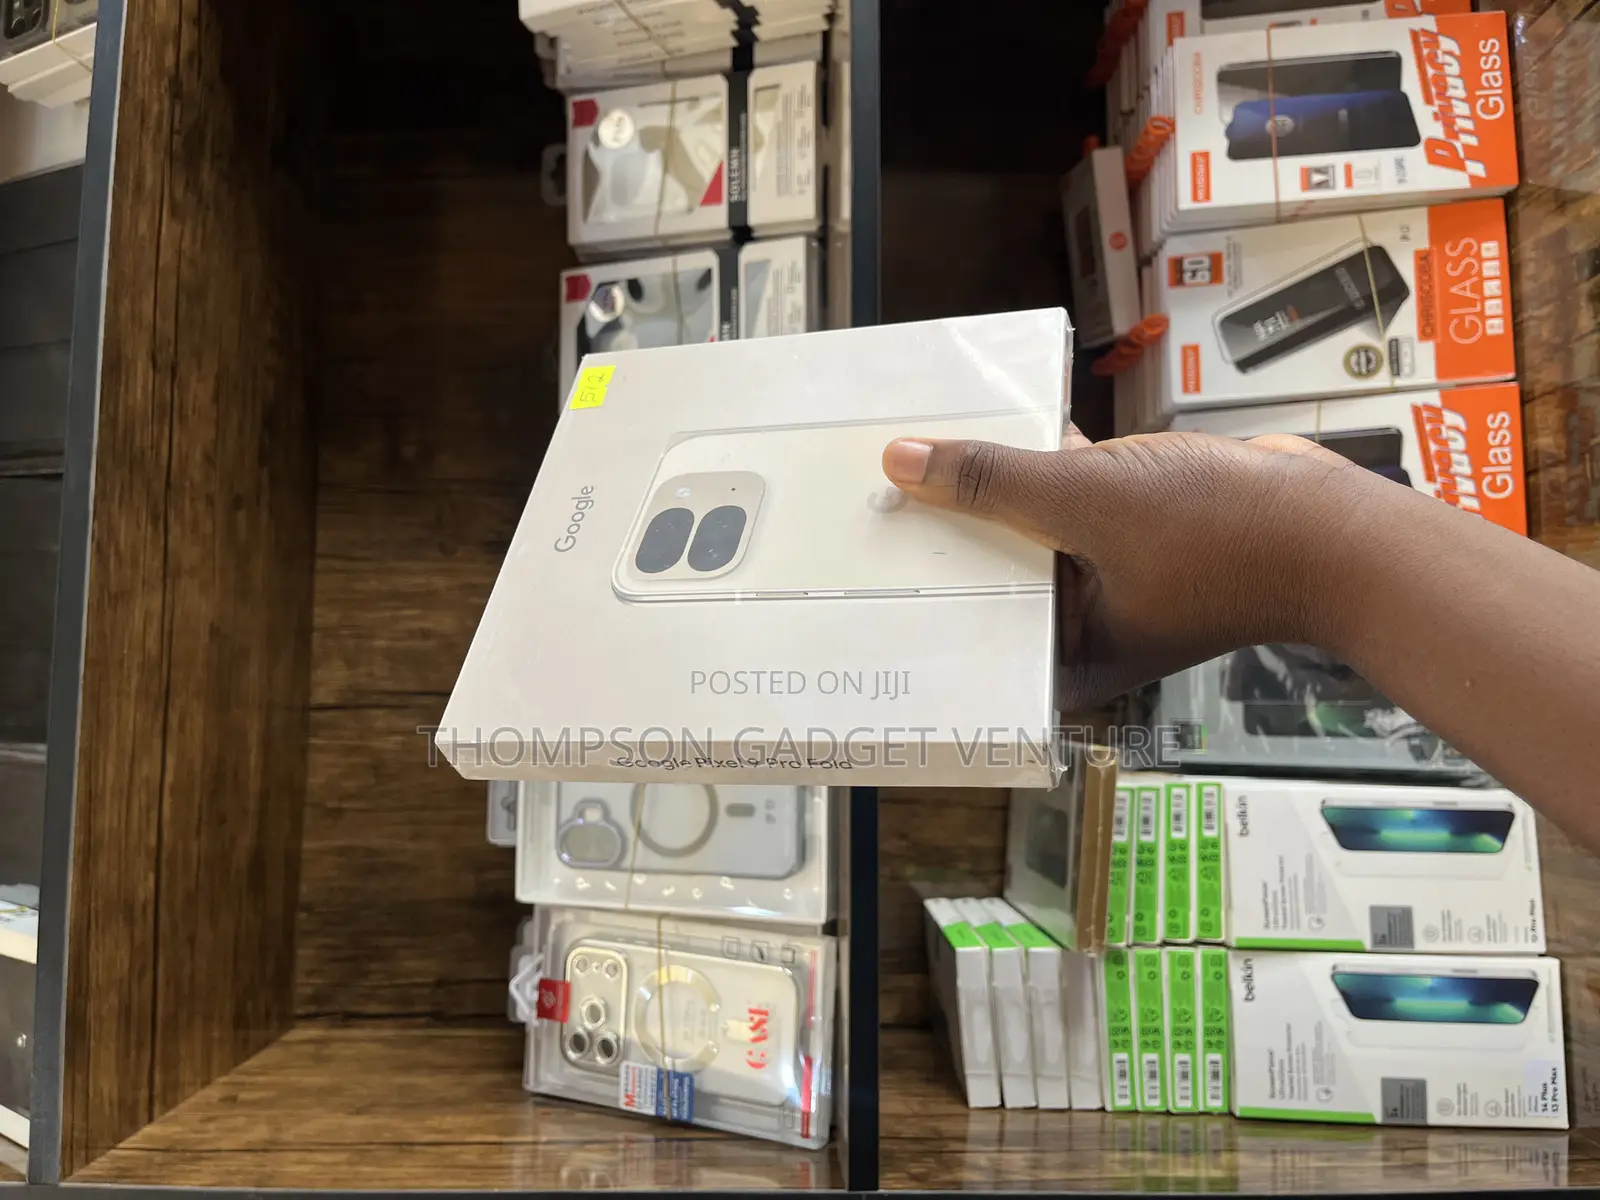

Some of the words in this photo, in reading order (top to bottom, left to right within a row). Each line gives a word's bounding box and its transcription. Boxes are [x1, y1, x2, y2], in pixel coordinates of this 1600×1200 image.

[1417, 28, 1487, 178] Privacy
[1475, 38, 1506, 119] Glass
[1445, 237, 1483, 344] GLASS
[1482, 411, 1515, 499] Glass
[554, 485, 595, 553] Google
[695, 756, 744, 769] Pixel
[766, 757, 802, 770] Pro
[807, 758, 853, 770] Fold
[1236, 794, 1250, 838] belkin
[1241, 957, 1255, 1003] belkin
